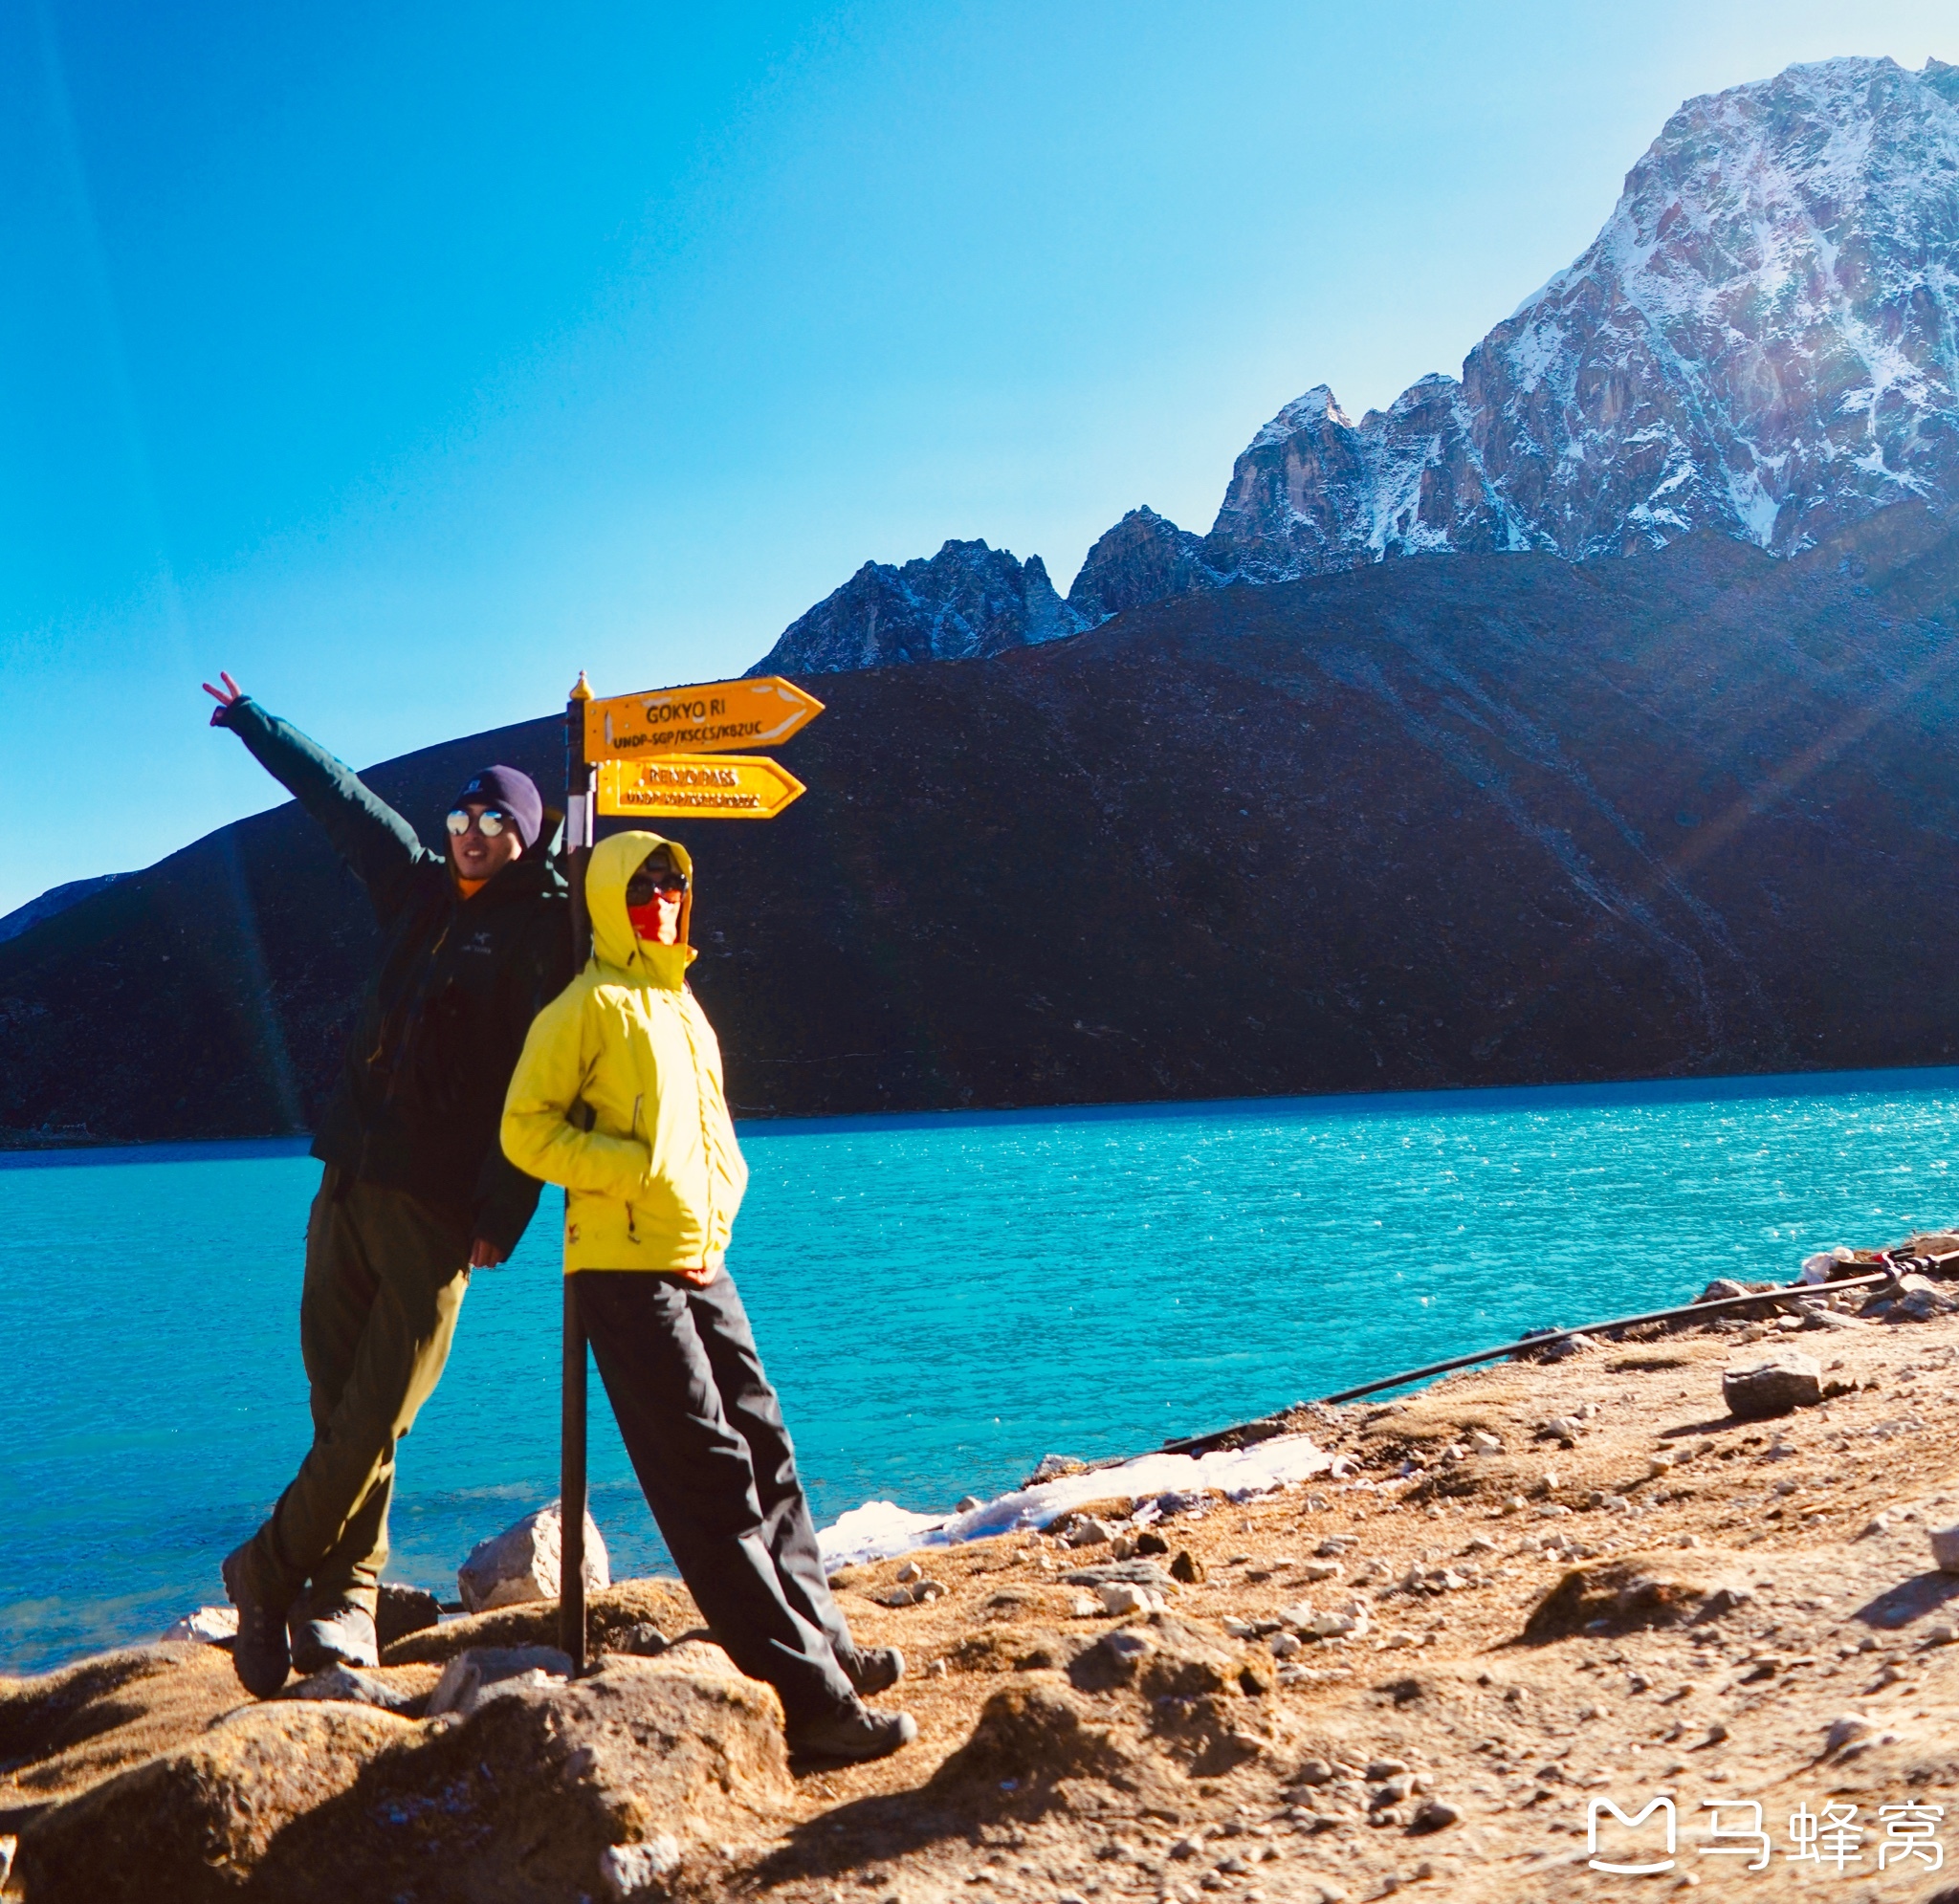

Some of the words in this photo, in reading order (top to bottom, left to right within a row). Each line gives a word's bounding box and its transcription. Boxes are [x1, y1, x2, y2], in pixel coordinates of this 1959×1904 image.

[647, 701, 705, 723] GOKYO
[710, 698, 726, 715] RI
[649, 766, 698, 784] RENJO
[702, 766, 739, 786] PASS
